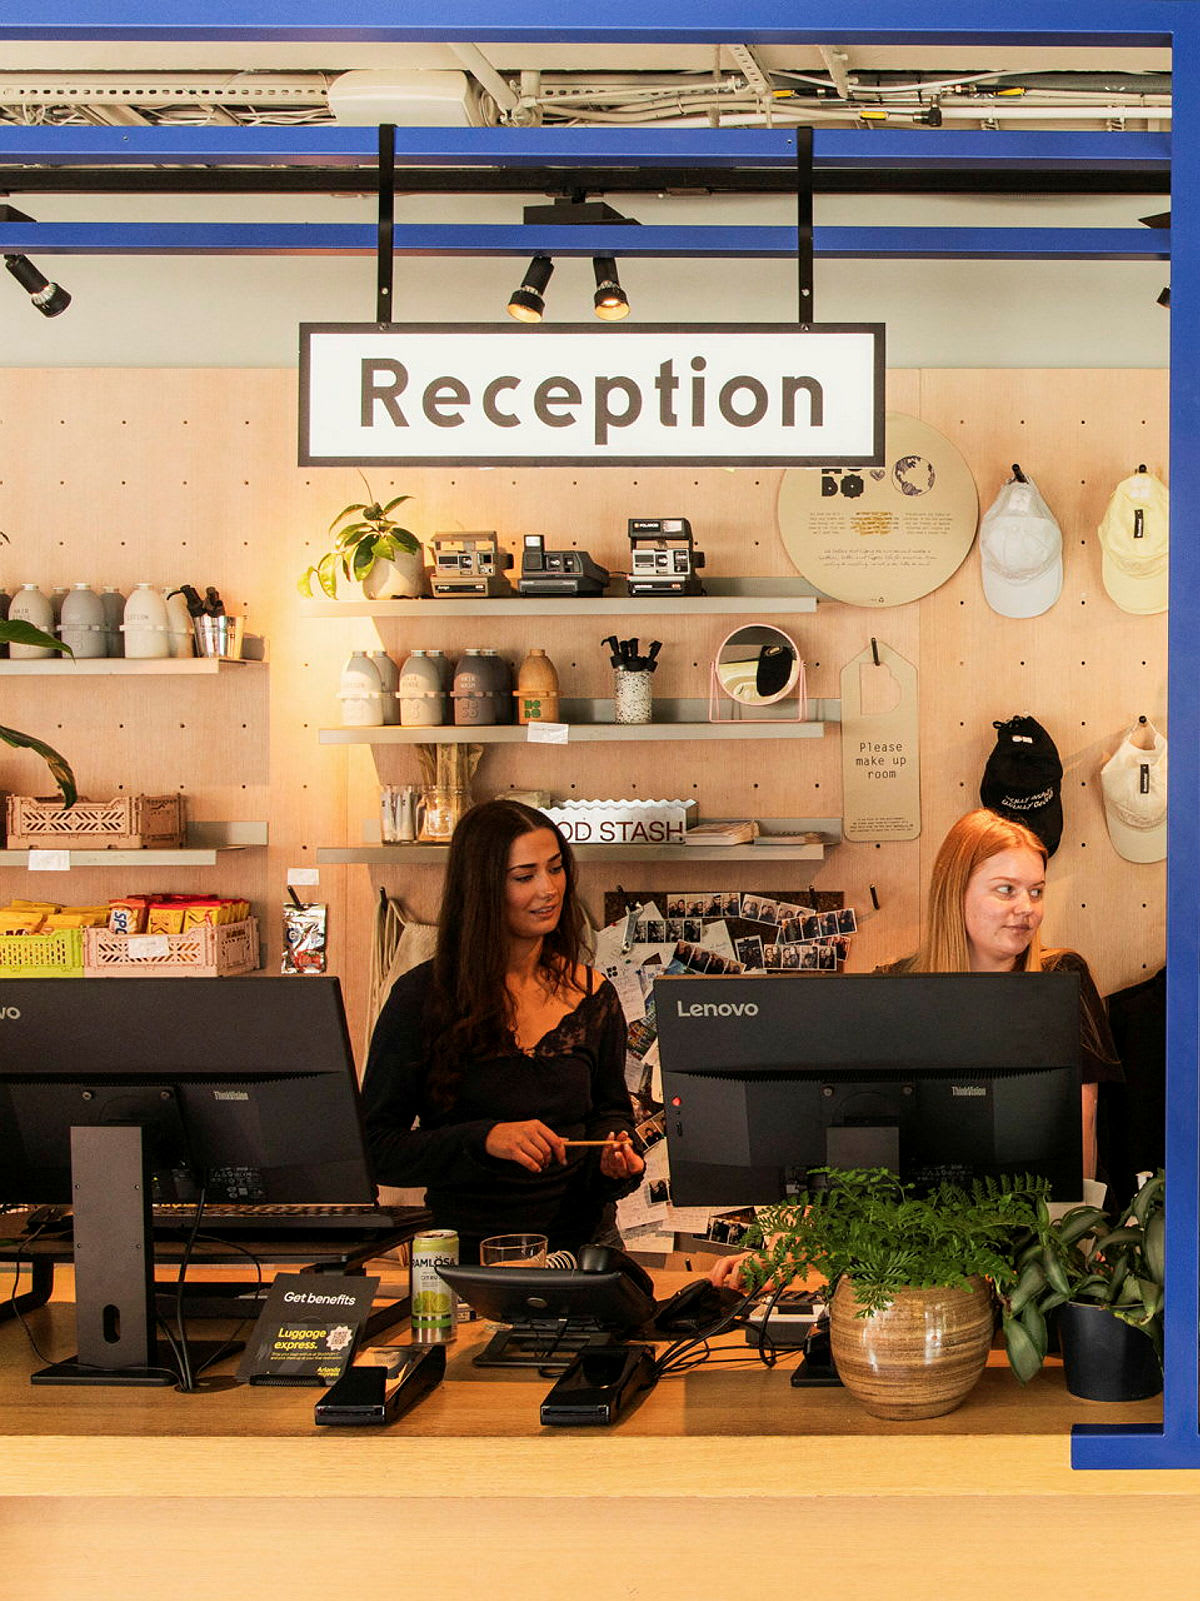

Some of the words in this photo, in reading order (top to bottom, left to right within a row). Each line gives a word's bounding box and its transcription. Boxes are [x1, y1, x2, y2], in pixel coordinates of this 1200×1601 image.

[360, 355, 824, 446] Reception
[859, 742, 903, 754] Please
[855, 756, 885, 767] make
[892, 756, 908, 767] up
[868, 770, 897, 780] room
[599, 821, 684, 842] STASH
[677, 1000, 759, 1017] Lenovo
[284, 1291, 307, 1303] Get
[307, 1292, 356, 1306] benefits
[278, 1327, 327, 1340] Luggage
[274, 1341, 319, 1352] express.
